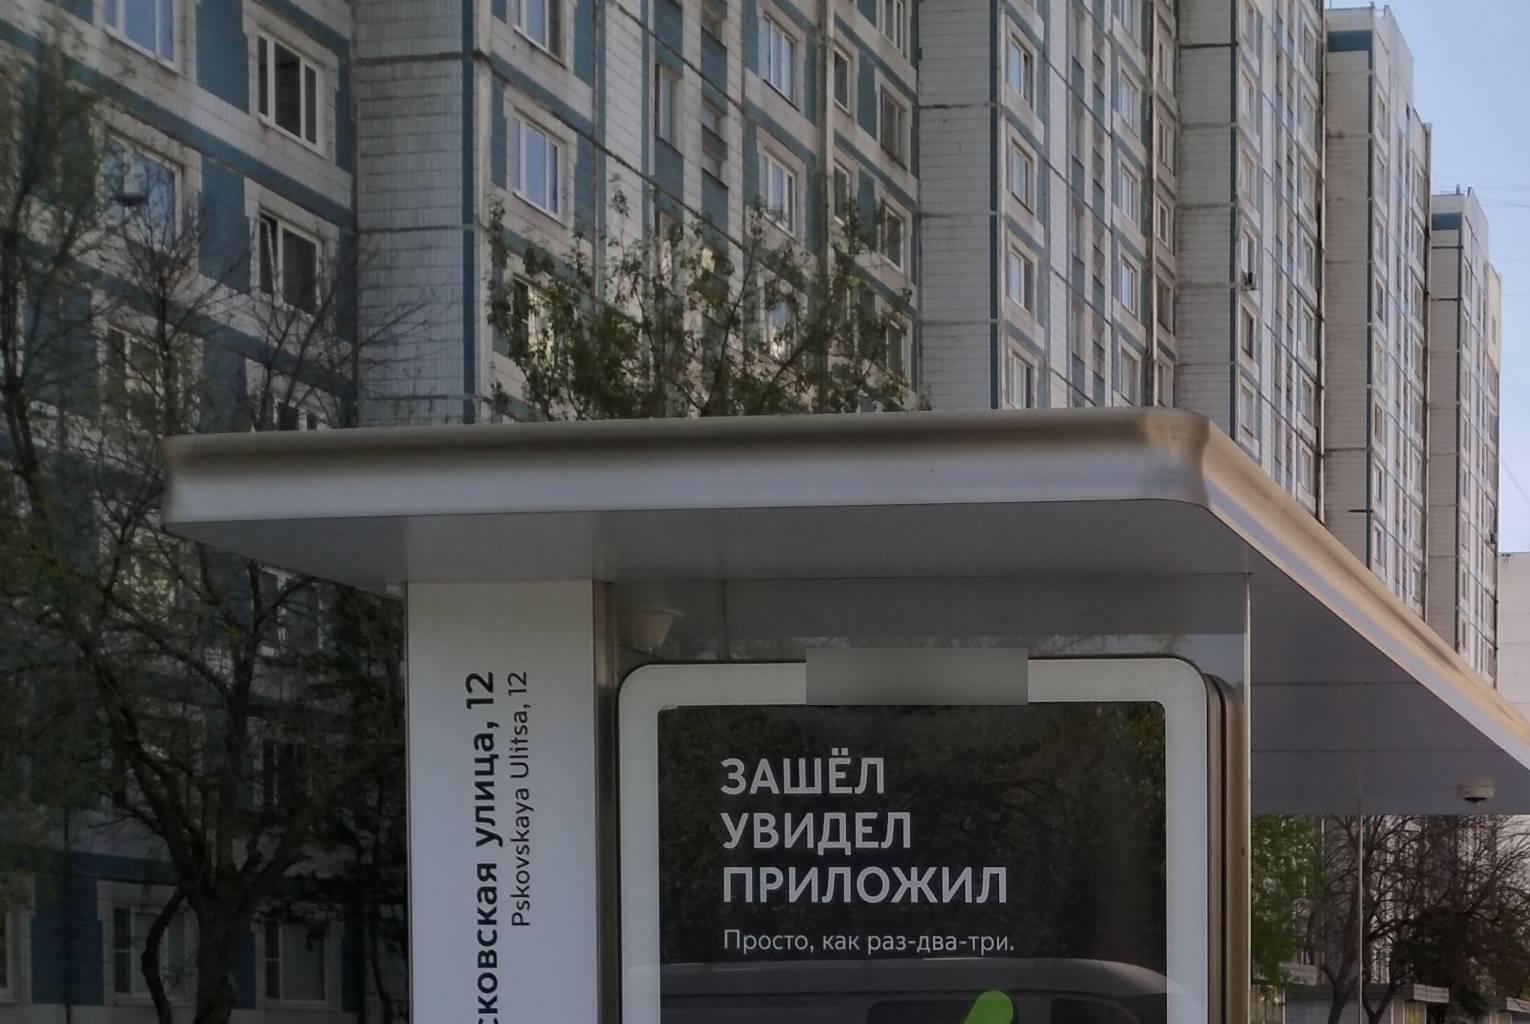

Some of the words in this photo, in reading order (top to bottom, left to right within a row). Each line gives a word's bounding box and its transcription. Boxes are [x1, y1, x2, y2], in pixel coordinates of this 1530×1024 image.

[464, 671, 496, 711] 12
[506, 671, 528, 697] 12
[507, 703, 532, 779] Ulitsa,
[473, 721, 505, 849] улица,
[721, 747, 885, 796] ЗАШЁЛ
[721, 812, 912, 855] УВИДЕЛ
[509, 787, 535, 928] Pskovskaya
[722, 866, 1008, 905] ПРИЛОЖИЛ
[724, 929, 815, 956] Просто,
[823, 934, 861, 951] как
[867, 934, 1015, 957] раз-два-три.
